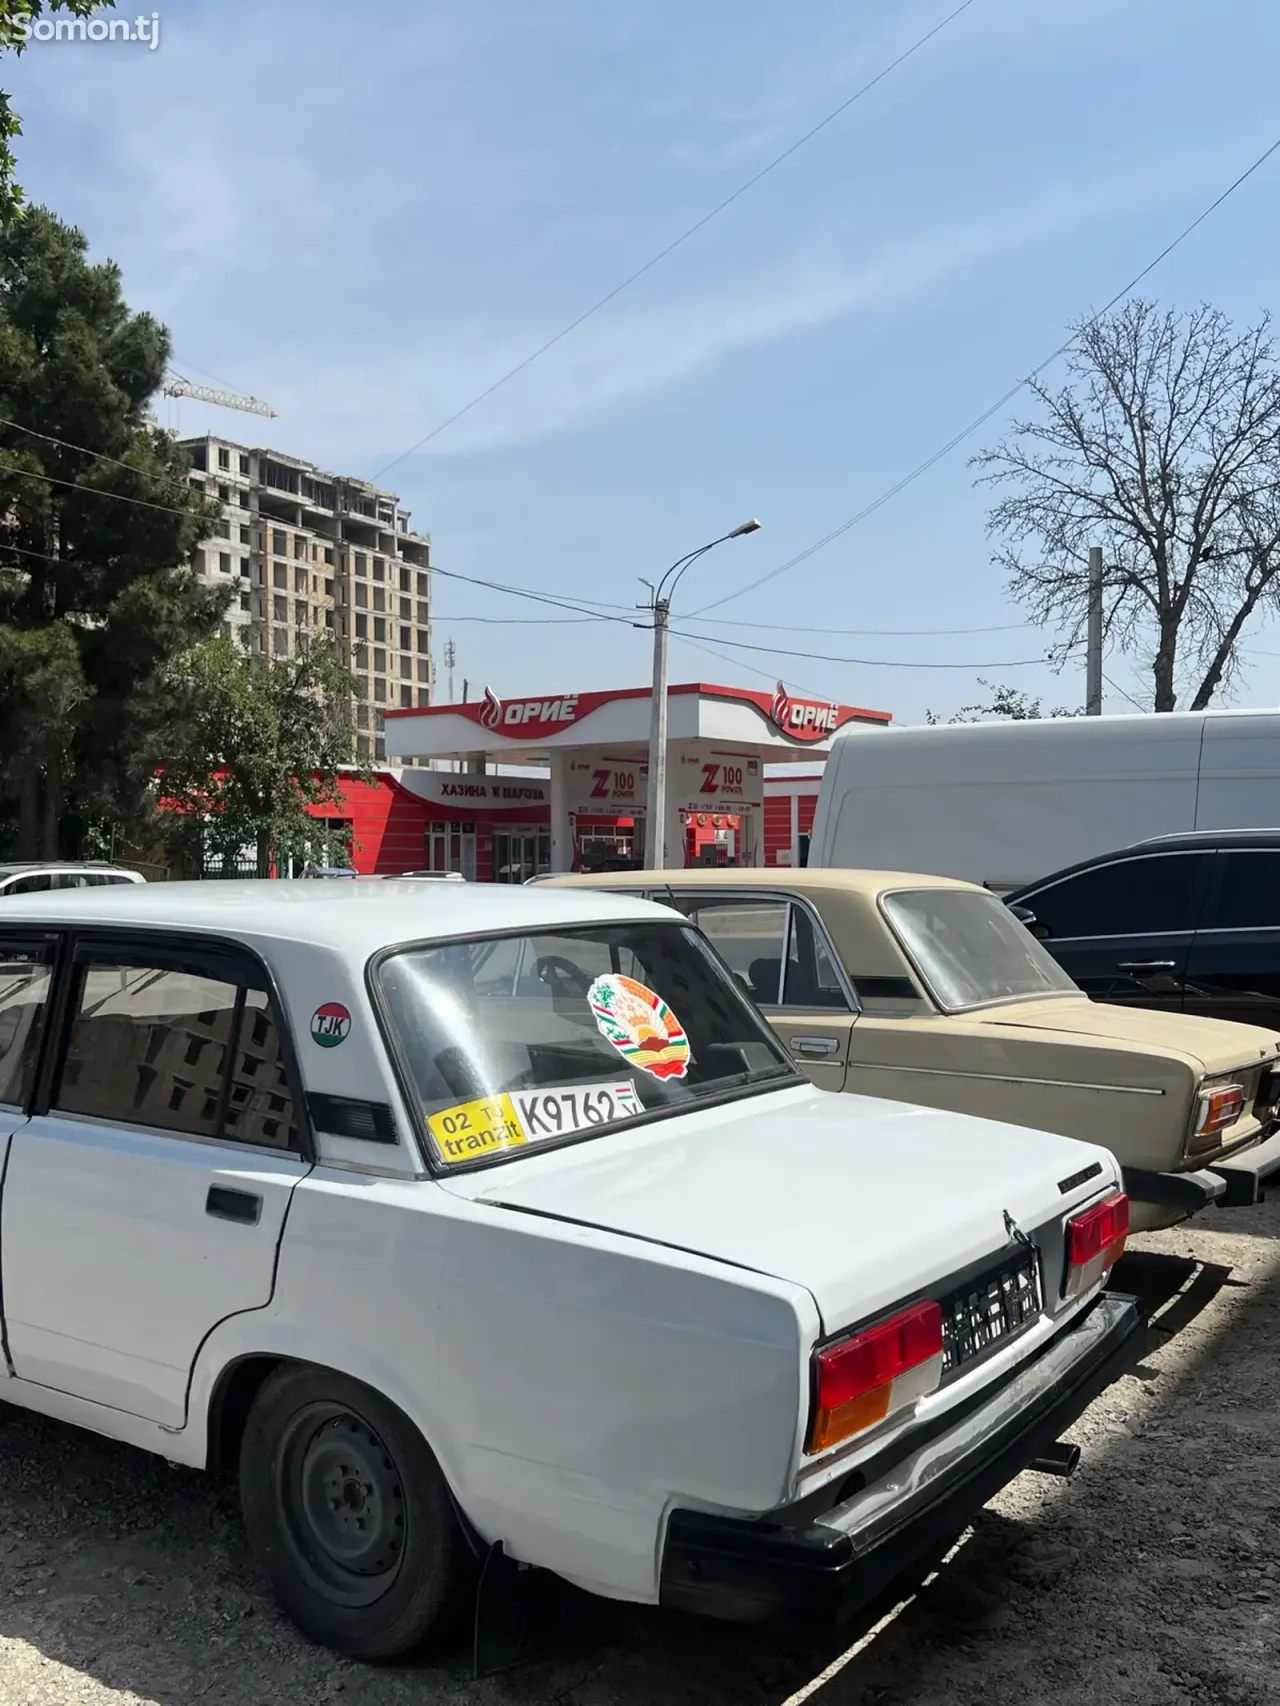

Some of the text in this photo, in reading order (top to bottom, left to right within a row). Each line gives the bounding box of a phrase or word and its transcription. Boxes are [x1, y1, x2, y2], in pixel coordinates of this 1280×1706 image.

[504, 694, 579, 724] ОРИЁ
[791, 703, 839, 729] ОРИЁ
[614, 772, 634, 790] 100
[722, 766, 742, 785] 100
[441, 783, 487, 798] ХАЗИНА
[318, 1015, 345, 1036] TJK
[442, 1112, 472, 1134] 02
[518, 1090, 619, 1135] K9762
[445, 1120, 521, 1155] tranzit
